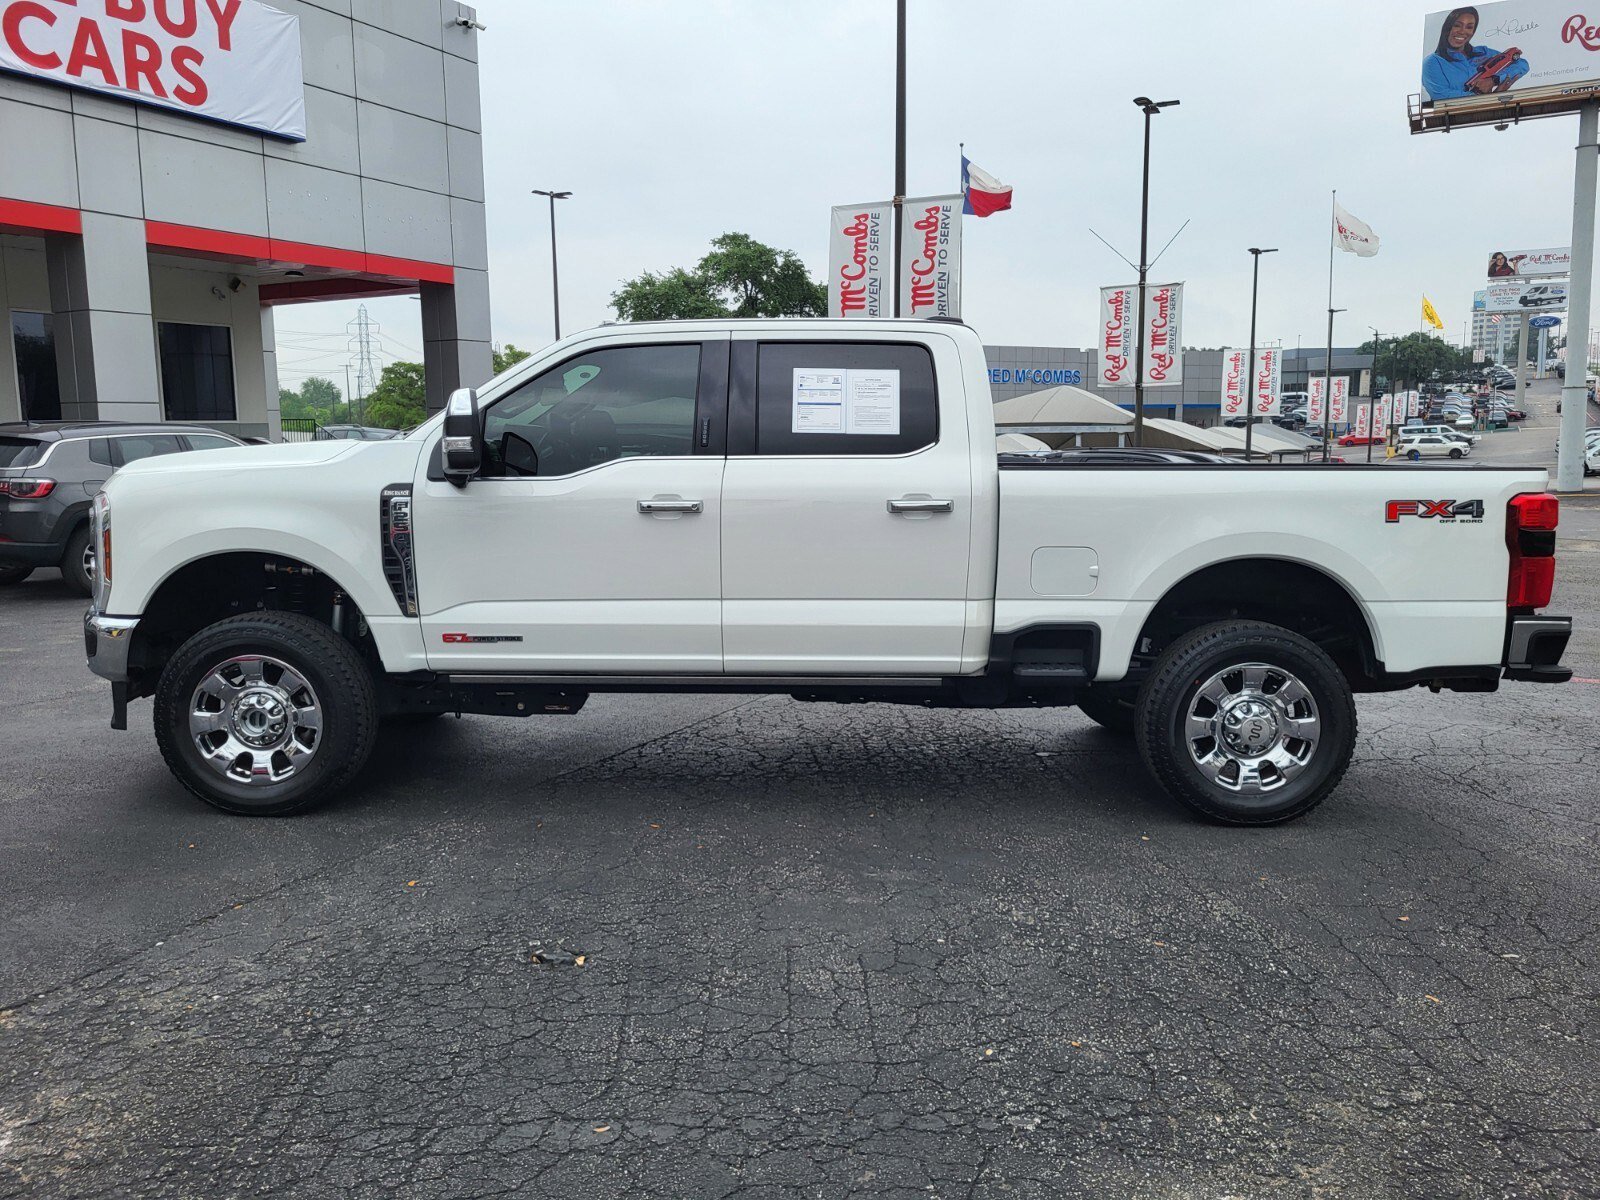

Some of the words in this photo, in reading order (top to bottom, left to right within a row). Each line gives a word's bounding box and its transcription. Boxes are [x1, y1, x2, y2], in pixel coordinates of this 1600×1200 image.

[2, 1, 208, 107] CARS
[1575, 65, 1590, 74] Ford
[869, 212, 881, 252] SERVE
[939, 205, 952, 245] SERVE
[840, 213, 869, 318] McCombs
[869, 253, 879, 272] TO
[911, 205, 941, 315] McCombs
[938, 249, 948, 267] TO
[868, 277, 880, 318] RIVEN
[1105, 290, 1124, 352] McCombs
[1124, 314, 1131, 325] TO
[1150, 288, 1170, 351] McCombs
[1169, 312, 1176, 323] TO
[1534, 317, 1555, 326] Ford
[1122, 328, 1130, 357] DRIVEN
[1168, 326, 1176, 355] DRIVEN
[1014, 369, 1081, 384] McCOMBS
[1104, 354, 1128, 382] Red
[1149, 353, 1174, 381] Red
[1226, 352, 1241, 394] McCombs
[1258, 351, 1273, 392] McCombs
[1225, 394, 1243, 413] Red
[1257, 393, 1275, 412] Red
[1385, 499, 1485, 523] FX4
